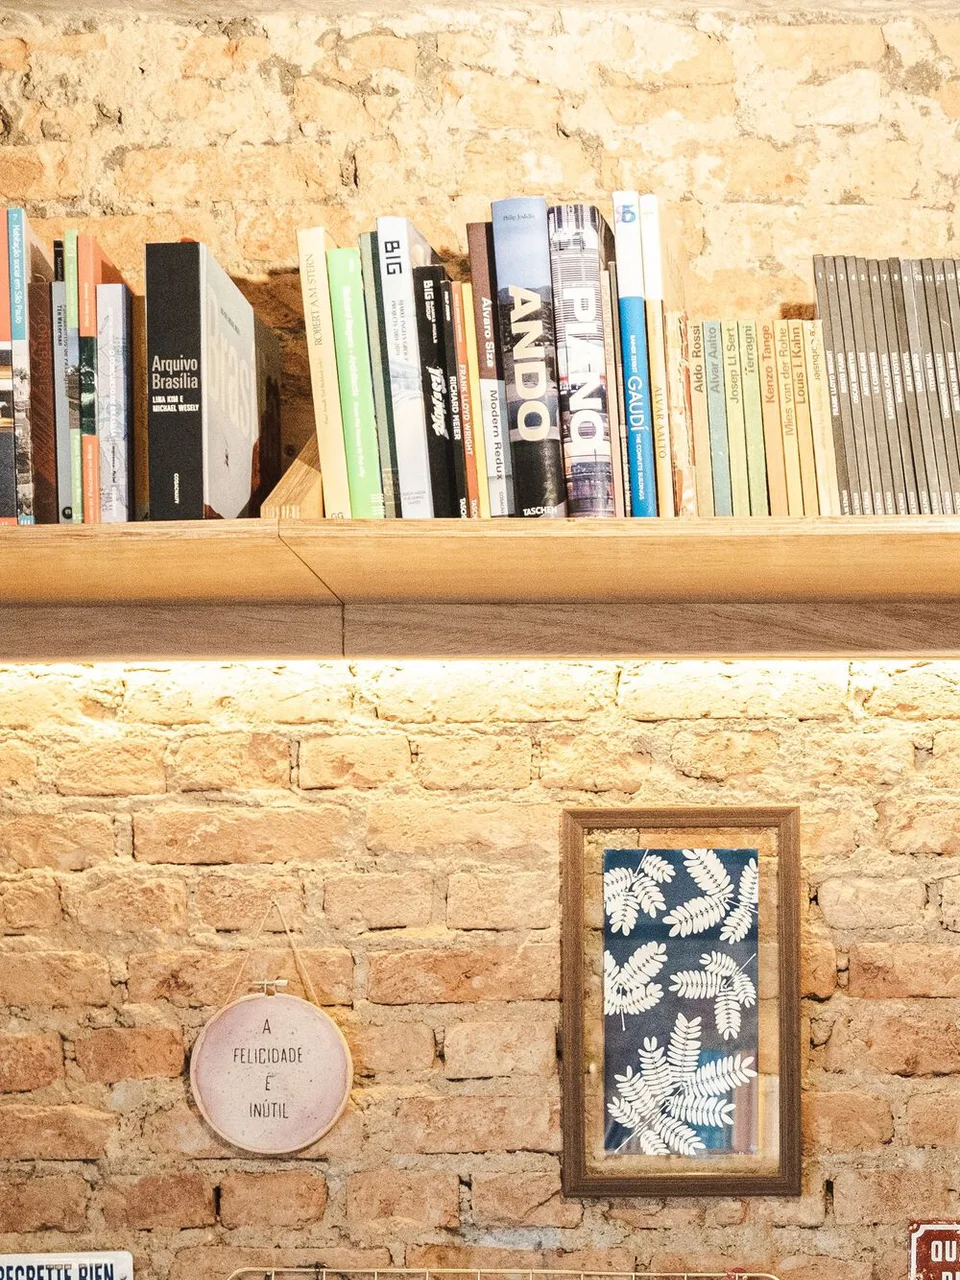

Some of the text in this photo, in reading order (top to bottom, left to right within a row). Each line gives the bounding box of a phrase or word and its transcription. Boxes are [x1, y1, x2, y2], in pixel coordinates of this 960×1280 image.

[305, 254, 316, 285] STERN
[384, 240, 402, 275] BIG
[423, 280, 434, 300] BIG
[14, 305, 22, 324] Paulo
[311, 311, 323, 346] ROBERT
[152, 355, 198, 375] Arquivo
[485, 341, 495, 368] Siza
[508, 283, 551, 442] ANDO
[689, 325, 704, 393] Aldo Rossi
[706, 327, 721, 394] Alvar Aalto
[726, 327, 740, 404] Josep Sert
[742, 325, 754, 375] Terragni
[761, 325, 775, 404] Kenzo Tange
[791, 326, 806, 405] Louis Kahn
[152, 372, 199, 390] Brasília
[562, 287, 608, 456] PIANO
[778, 327, 795, 436] Mies van der Rohe
[829, 375, 837, 395] LLOYD
[449, 376, 461, 441] RICHARD MEIER
[459, 364, 473, 456] FRANK LLOYD WRIGHT
[628, 375, 648, 432] GAUDÍ
[653, 386, 667, 459] ALVAR AALTO
[886, 389, 895, 420] SANTIAGO
[489, 389, 503, 481] Modern Redux
[522, 505, 557, 517] TASCHEN
[261, 1018, 272, 1034] A
[232, 1046, 304, 1064] FELICIDADE
[248, 1096, 289, 1119] INÚTIL
